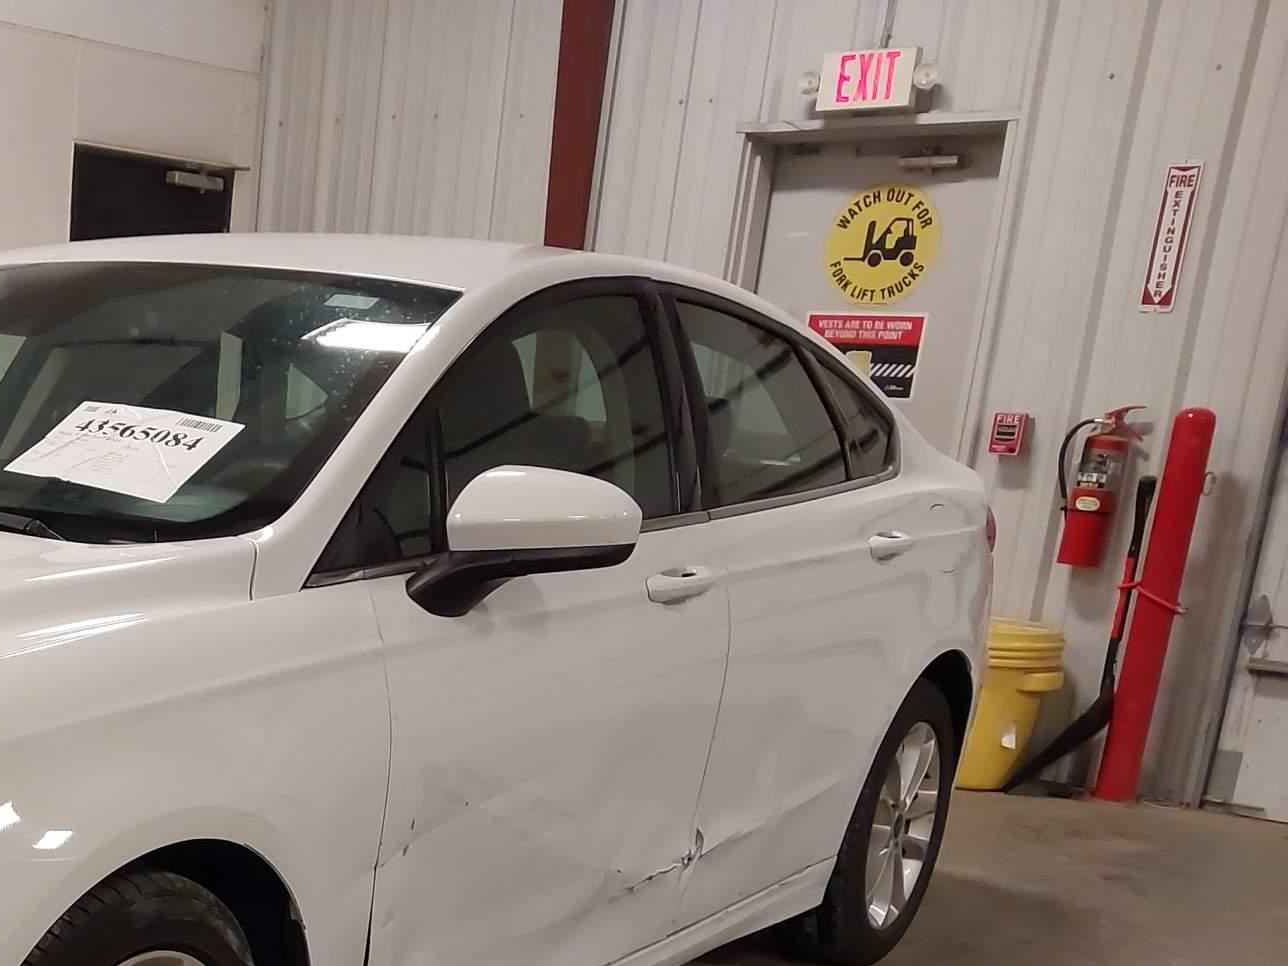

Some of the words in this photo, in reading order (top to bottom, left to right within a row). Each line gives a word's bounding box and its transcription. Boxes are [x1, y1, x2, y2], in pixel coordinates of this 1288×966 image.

[836, 51, 901, 102] EXIT
[1168, 174, 1196, 188] FIRE
[836, 190, 881, 230] WATCH
[886, 188, 914, 206] OUT
[912, 200, 933, 229] FOR
[1153, 190, 1183, 298] EXTINGUISHER
[829, 261, 853, 292] FORK
[849, 285, 876, 302] LIFT
[879, 262, 925, 300] TRUCKS
[819, 319, 844, 329] VESTS
[844, 320, 861, 329] ARE
[863, 320, 872, 329] TO
[875, 321, 884, 330] BE
[887, 321, 912, 330] WORN
[824, 330, 857, 338] BEYOND
[859, 330, 876, 339] THIS
[878, 331, 903, 340] POINT
[74, 418, 204, 451] 43565084
[997, 415, 1021, 424] FIRE
